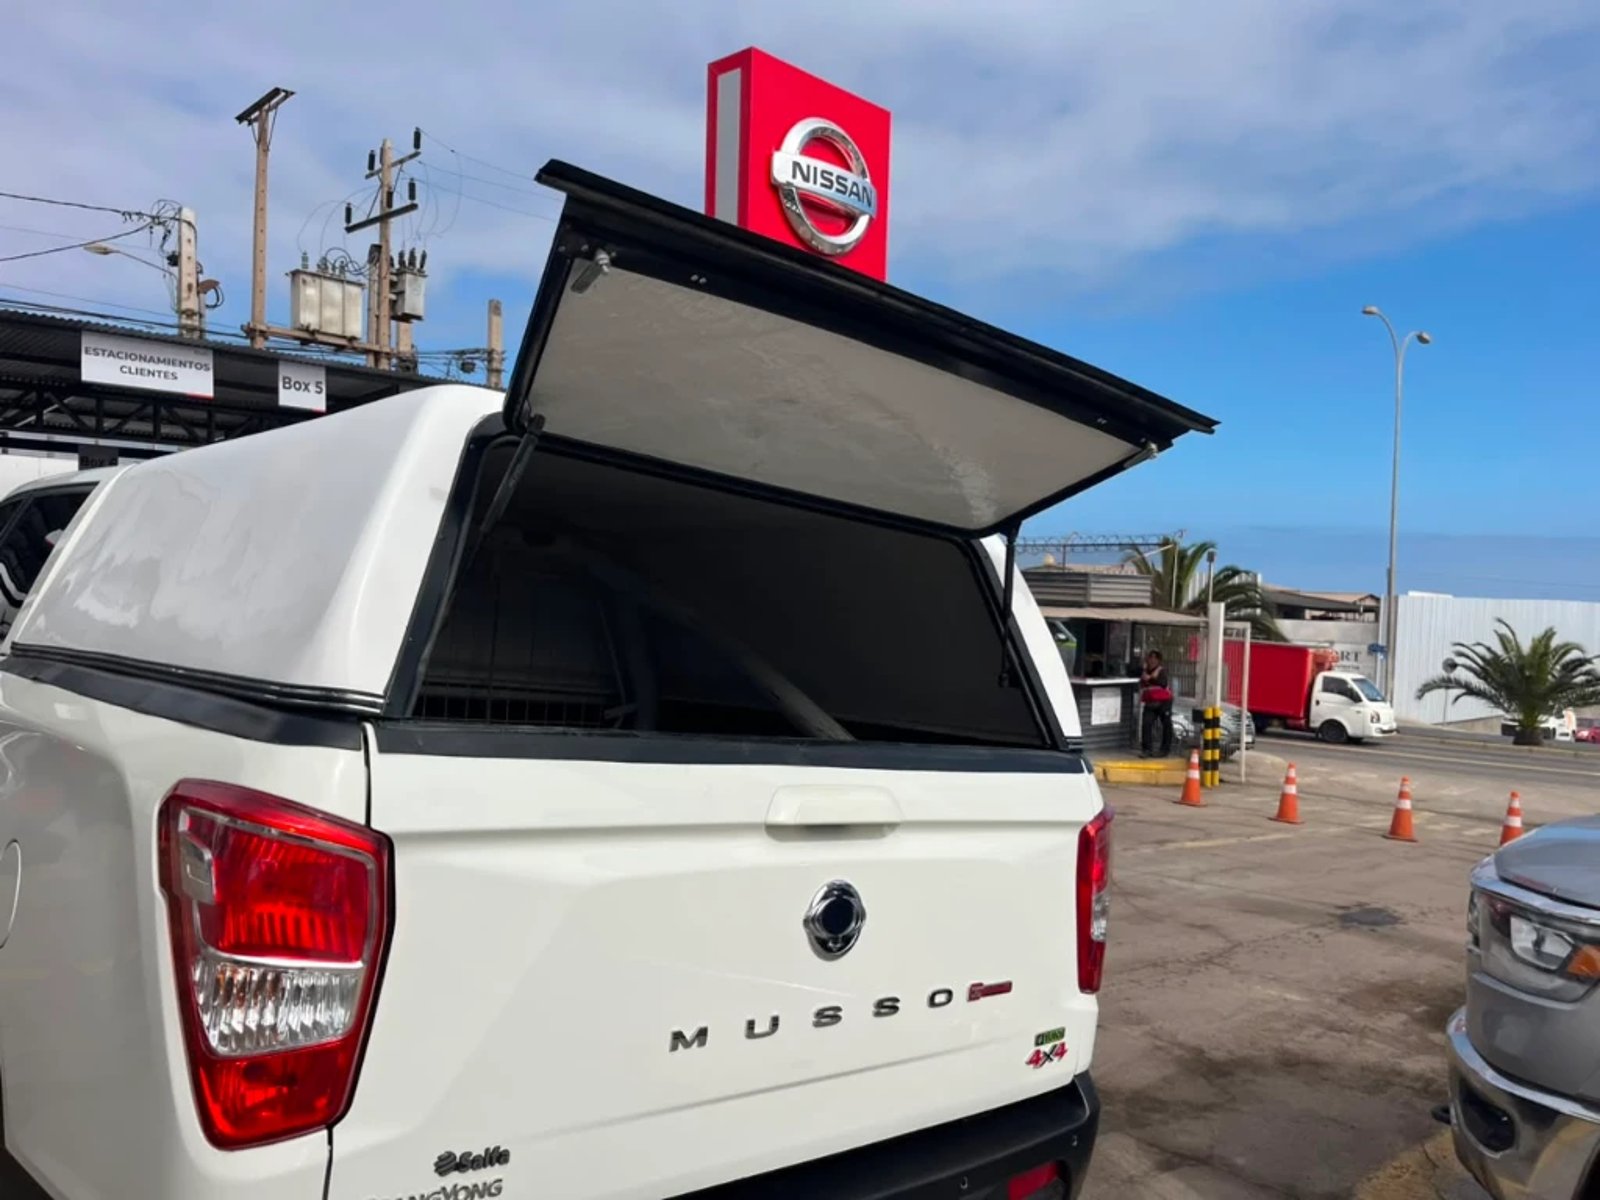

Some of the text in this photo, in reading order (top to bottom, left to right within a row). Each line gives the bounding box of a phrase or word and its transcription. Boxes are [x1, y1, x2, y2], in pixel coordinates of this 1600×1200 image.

[792, 160, 873, 209] NISSAN
[84, 346, 211, 373] ESTACIONAMIENTOS
[119, 364, 179, 381] CLIENTES
[281, 375, 324, 395] Box 5
[80, 455, 105, 467] Box
[669, 988, 954, 1052] MUSSO
[458, 1145, 511, 1173] Salfa
[366, 1179, 503, 1200] GYONG
